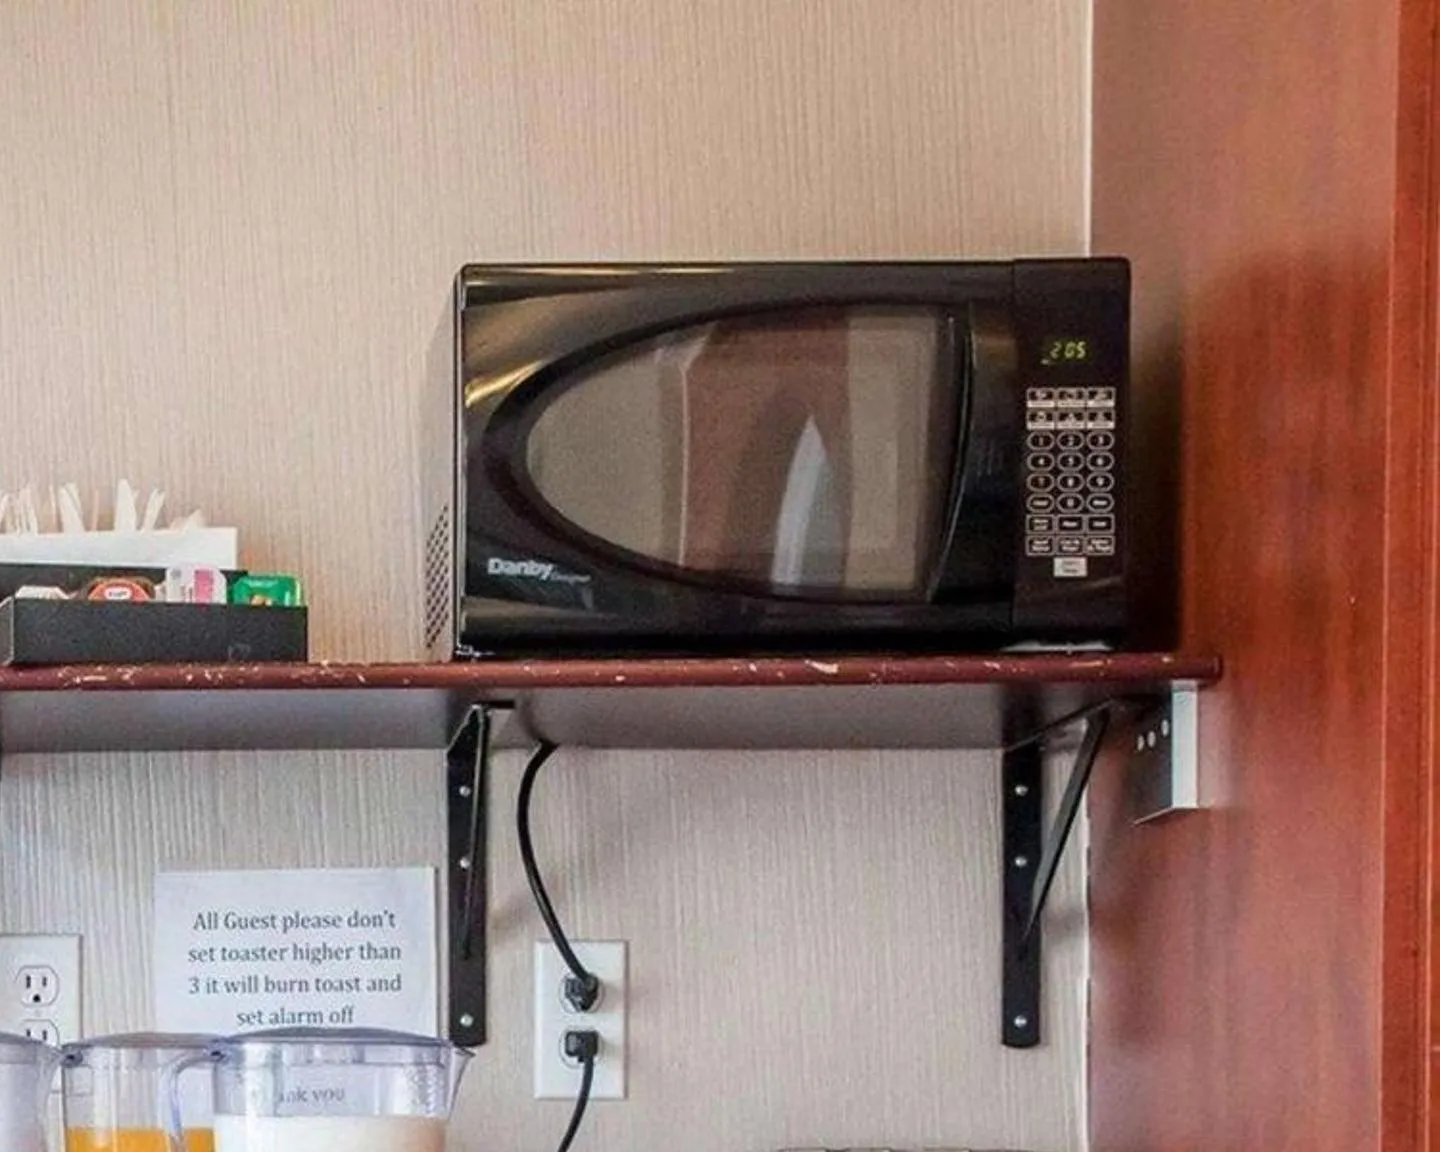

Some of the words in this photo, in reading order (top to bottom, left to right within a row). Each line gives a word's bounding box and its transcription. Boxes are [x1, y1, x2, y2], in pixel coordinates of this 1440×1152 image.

[487, 557, 554, 581] Danby
[193, 911, 219, 930] All
[223, 911, 277, 931] Guest
[282, 911, 343, 934] please
[347, 909, 396, 930] don't
[188, 946, 216, 962] set
[221, 946, 287, 962] toaster
[292, 942, 353, 965] higher
[359, 942, 402, 961] than
[188, 976, 200, 994] 3
[206, 976, 219, 994] it
[224, 976, 259, 994] will
[264, 976, 310, 993] burn
[315, 976, 360, 993] toast
[366, 974, 402, 992] and
[236, 1008, 264, 1026] set
[268, 1007, 323, 1025] alarm
[329, 1005, 356, 1024] off
[312, 1087, 345, 1106] you
